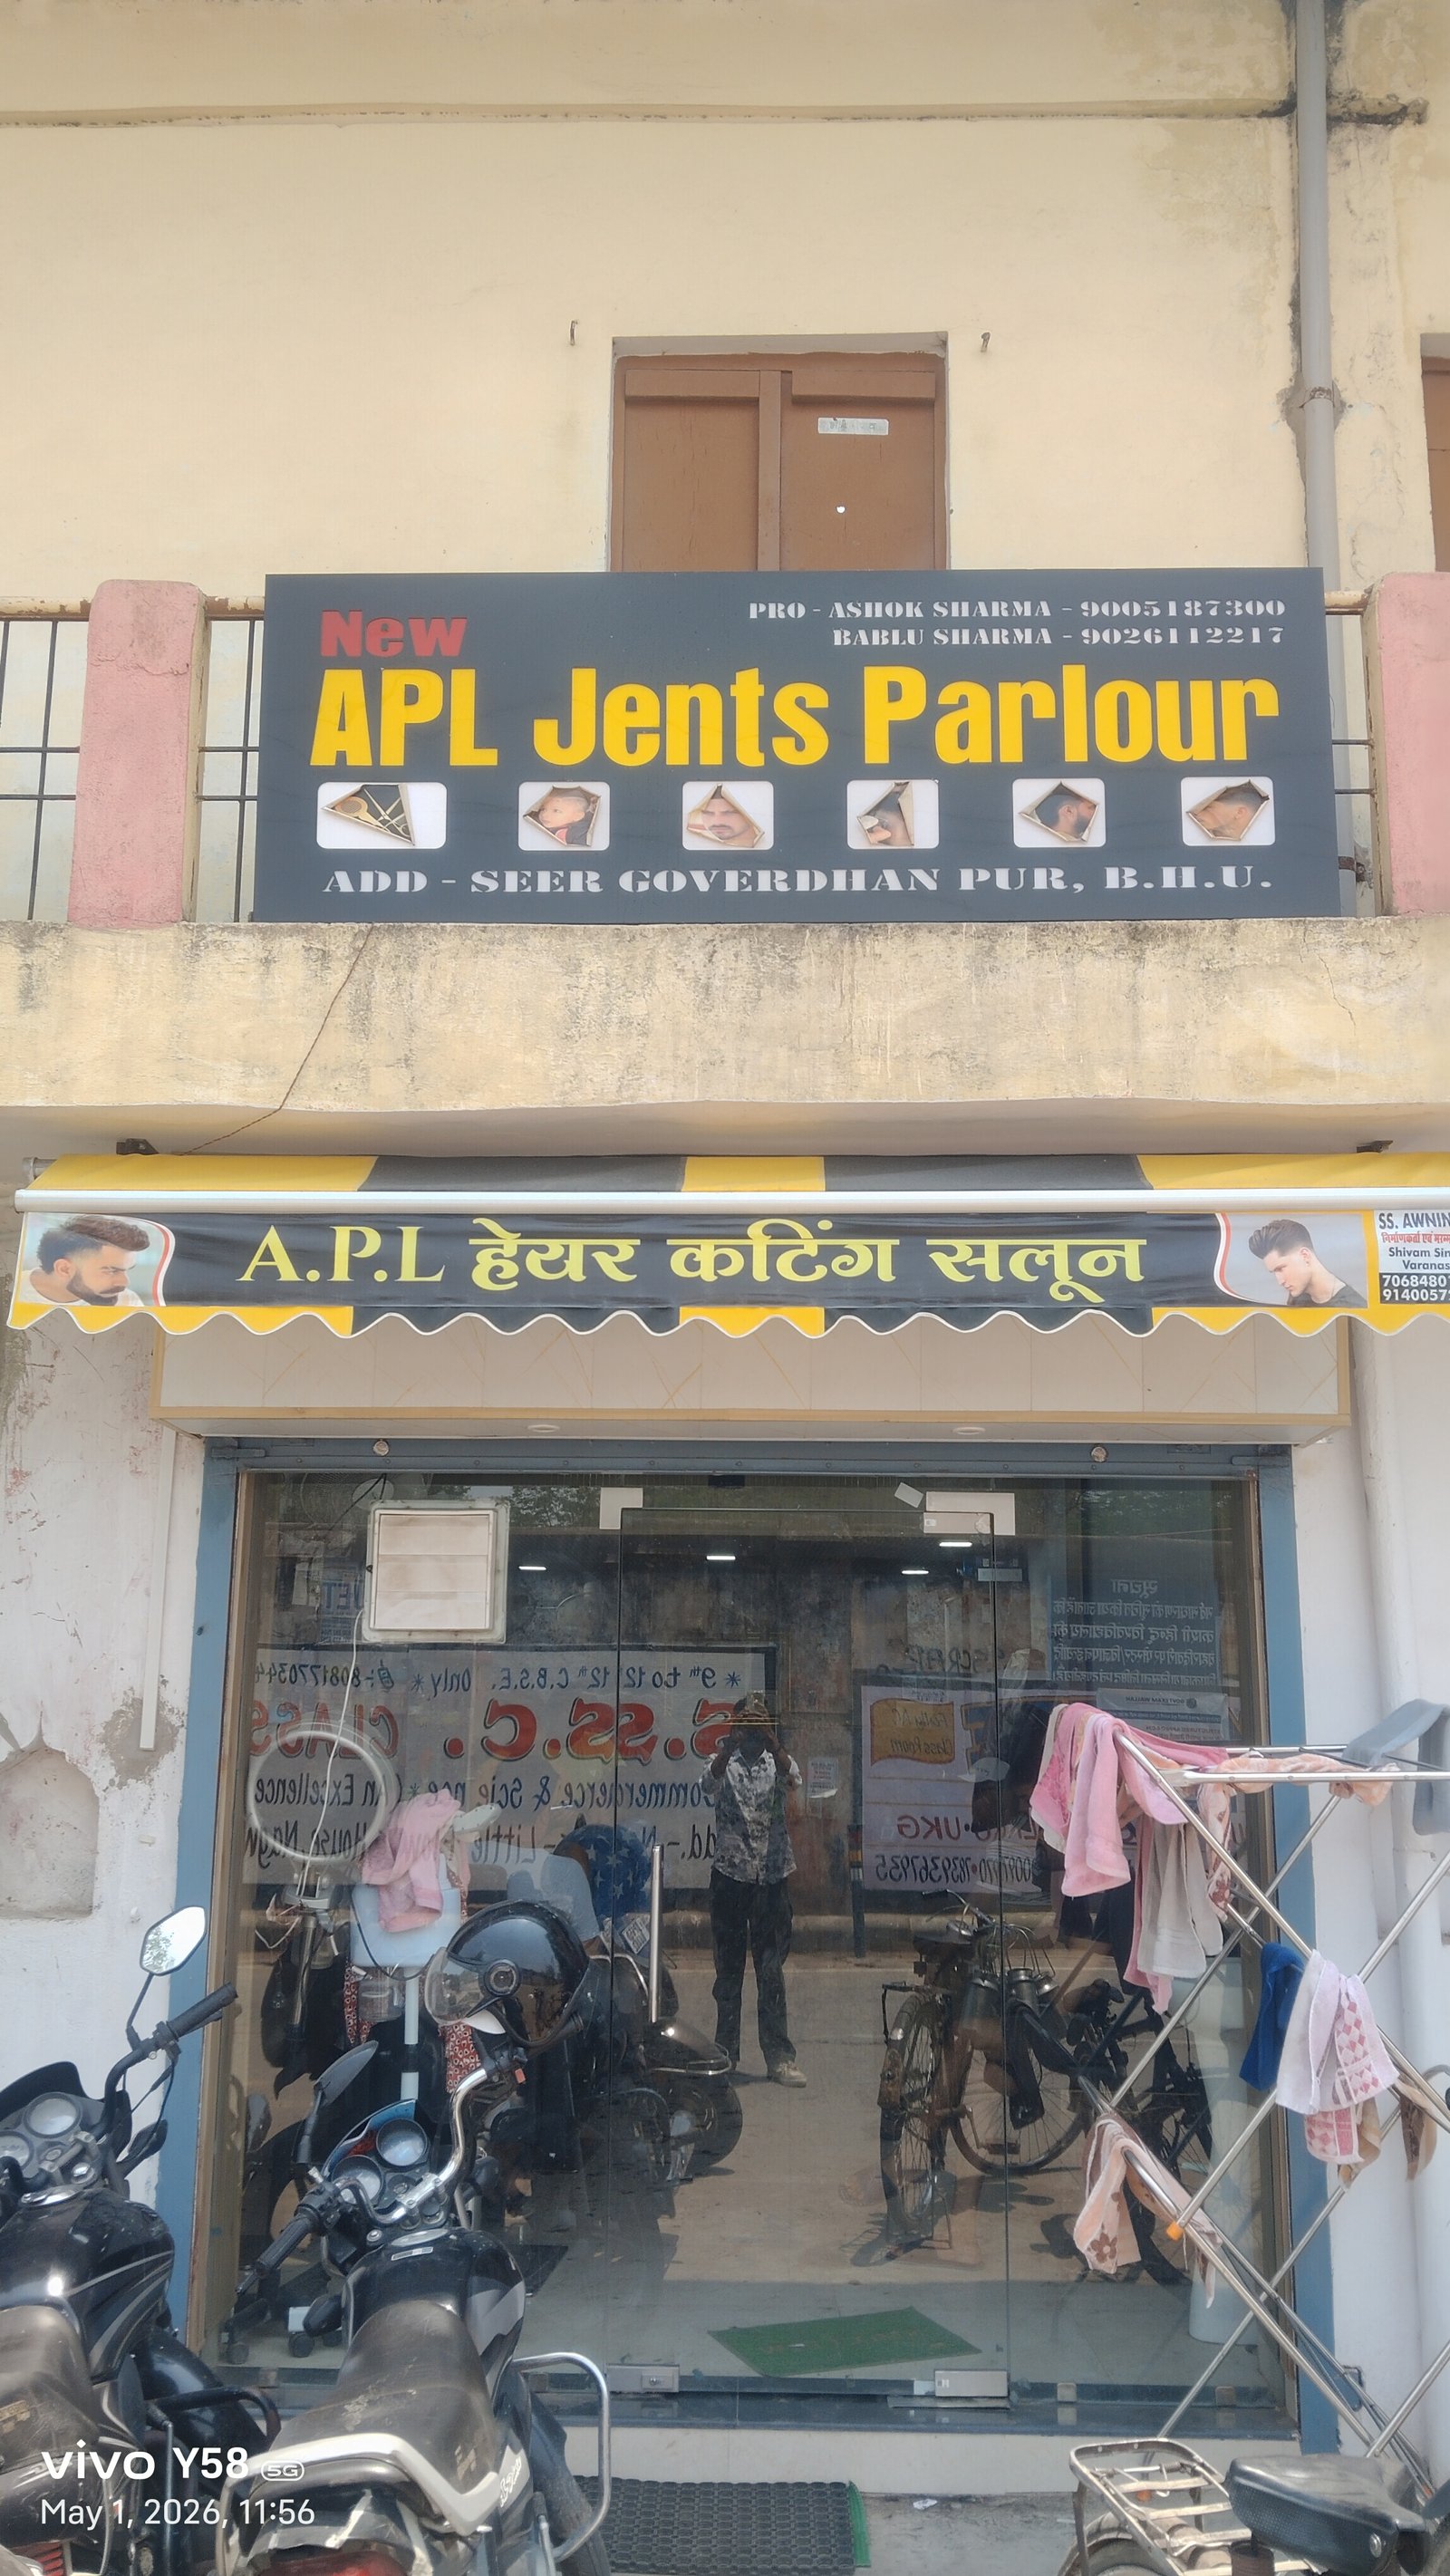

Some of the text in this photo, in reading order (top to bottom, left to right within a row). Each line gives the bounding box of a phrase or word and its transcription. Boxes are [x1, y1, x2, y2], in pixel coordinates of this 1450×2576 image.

[749, 602, 806, 619] PRO
[828, 601, 923, 618] ASHOK
[933, 600, 1051, 617] SHARMA
[1080, 599, 1285, 617] 9005187300
[320, 609, 468, 657] New
[833, 628, 923, 646] BABLU
[933, 627, 1052, 645] SHARMA
[1081, 626, 1283, 645] 9026112217
[310, 663, 1280, 767] APL Jents Parlour
[323, 869, 428, 892] ADD
[470, 869, 604, 893] SEER
[618, 867, 938, 893] GOVERDHAN
[958, 866, 1085, 893] PUR,
[1104, 864, 1272, 890] B.H.U.
[1378, 1212, 1398, 1230] SS.
[235, 1217, 1146, 1303] A.P.L हेयर कटिंग सलून
[1388, 1247, 1430, 1258] Shivam
[1382, 1275, 1450, 1287] 7068480
[1382, 1288, 1450, 1301] 9140057
